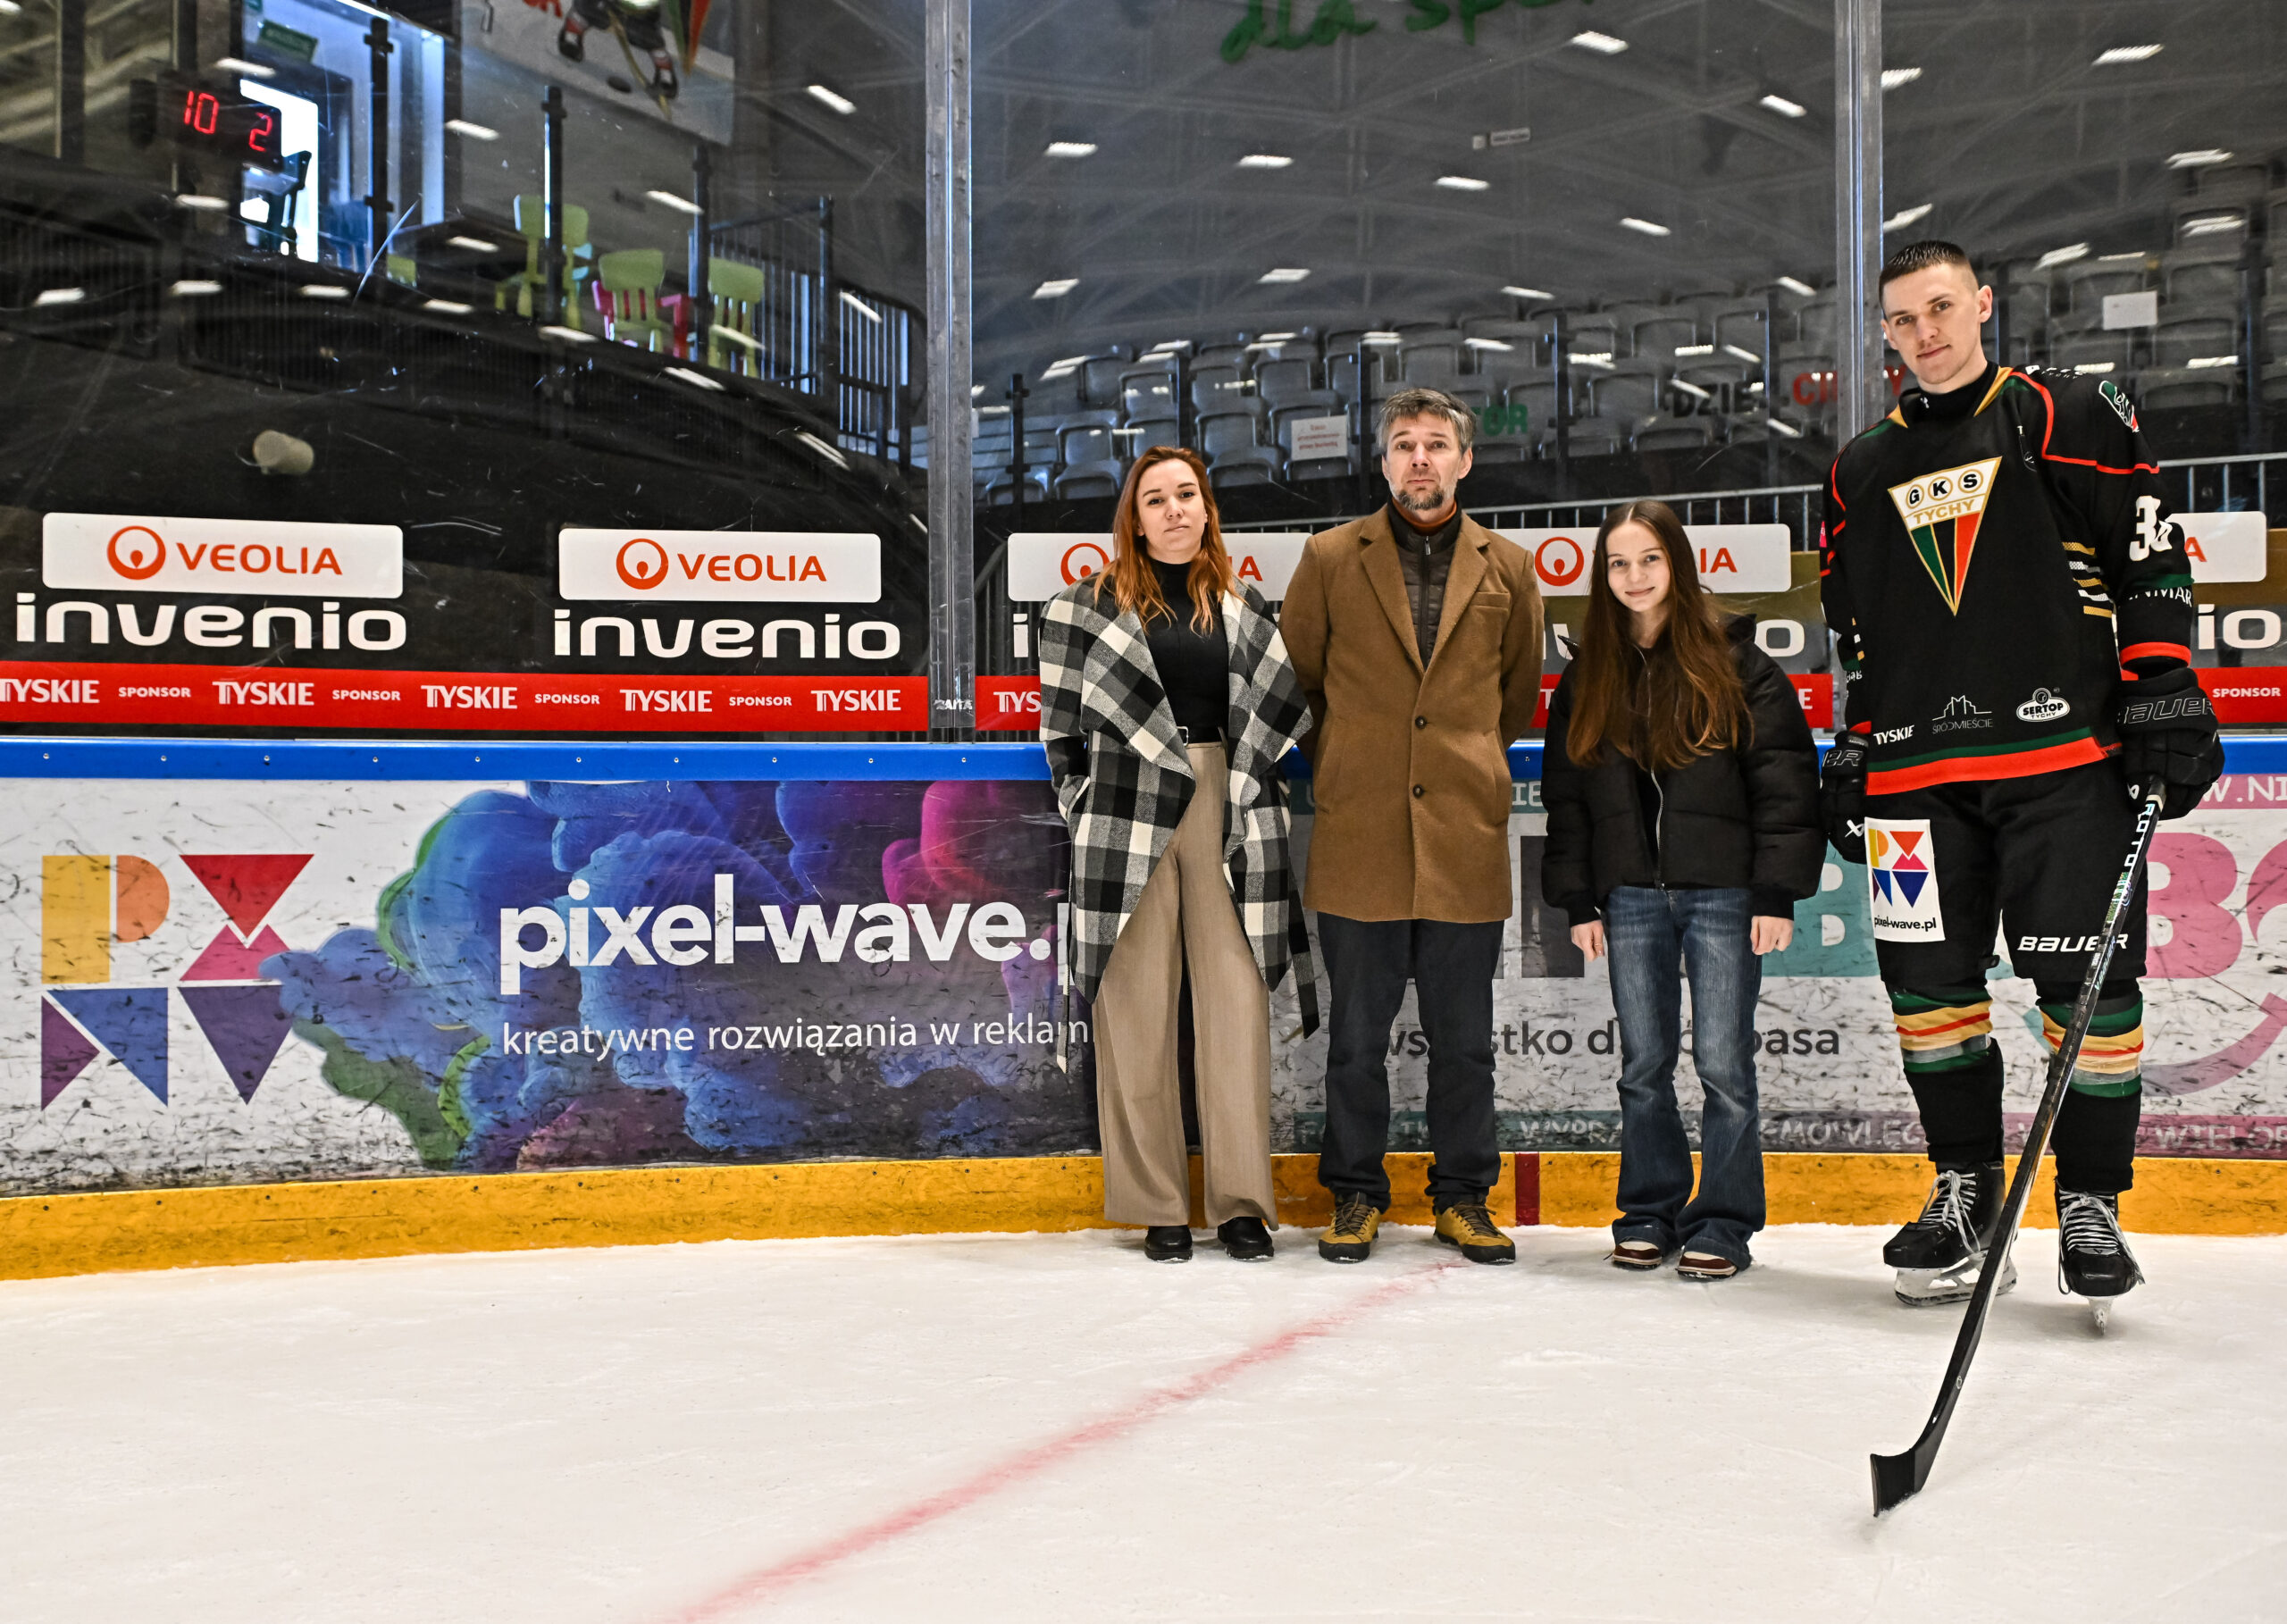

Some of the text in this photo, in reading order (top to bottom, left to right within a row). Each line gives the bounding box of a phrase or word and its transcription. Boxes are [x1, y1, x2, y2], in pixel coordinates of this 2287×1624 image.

[248, 112, 272, 152] 2
[1909, 473, 1978, 505] GKS
[1914, 499, 1974, 524] TYCHY
[176, 542, 343, 575] VEOLIA
[676, 553, 827, 582] VEOLIA
[16, 592, 407, 651] invenio
[554, 609, 901, 659] invenio
[0, 678, 901, 712] TYSKIE SPONSOR TYSKIE SPONSOR TYSKIE SPONSOR TYSKIE SPONSOR TYSKIE
[993, 691, 1041, 713] TYS
[2212, 687, 2282, 698] SPONSOR
[2023, 702, 2064, 716] SERTOP
[1873, 724, 1914, 745] TYSKIE
[499, 874, 1068, 995] pixel-wave.
[1874, 915, 1937, 932] pixel-wave.pl
[504, 1012, 1095, 1061] kreatywne rozwiązania w reklam
